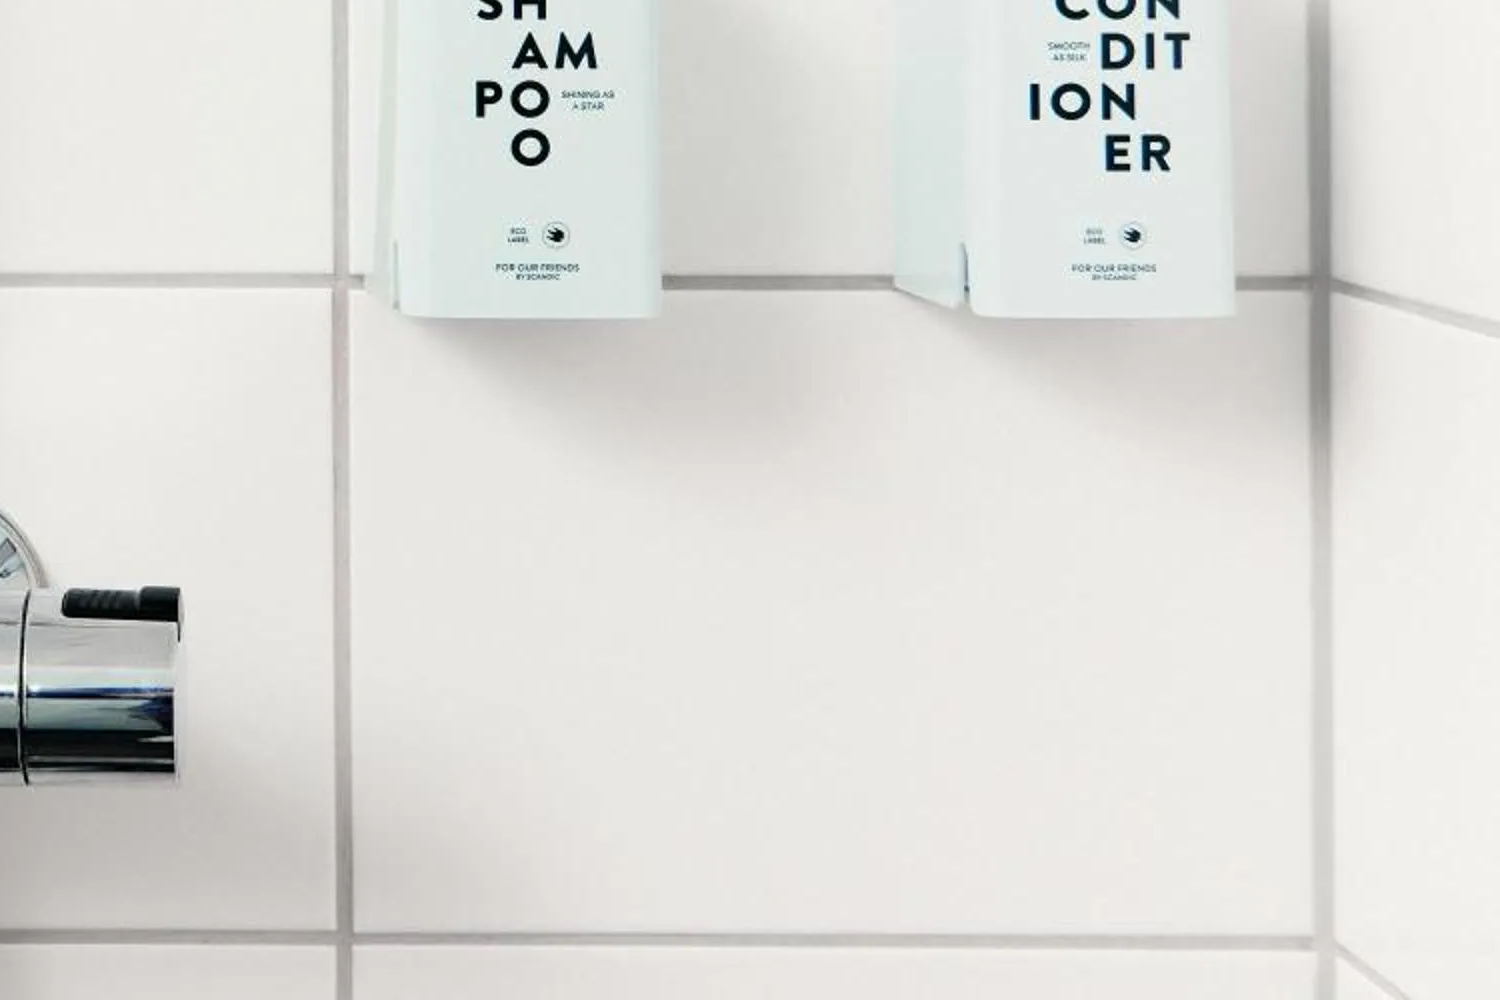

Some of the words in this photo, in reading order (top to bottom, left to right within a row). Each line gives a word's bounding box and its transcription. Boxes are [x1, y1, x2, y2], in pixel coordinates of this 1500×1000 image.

[511, 31, 598, 70] AM
[1100, 32, 1191, 70] DIT
[475, 79, 551, 119] PO
[581, 101, 605, 110] STAR
[1029, 82, 1136, 121] ION
[510, 128, 551, 167] O
[1105, 133, 1171, 172] ER
